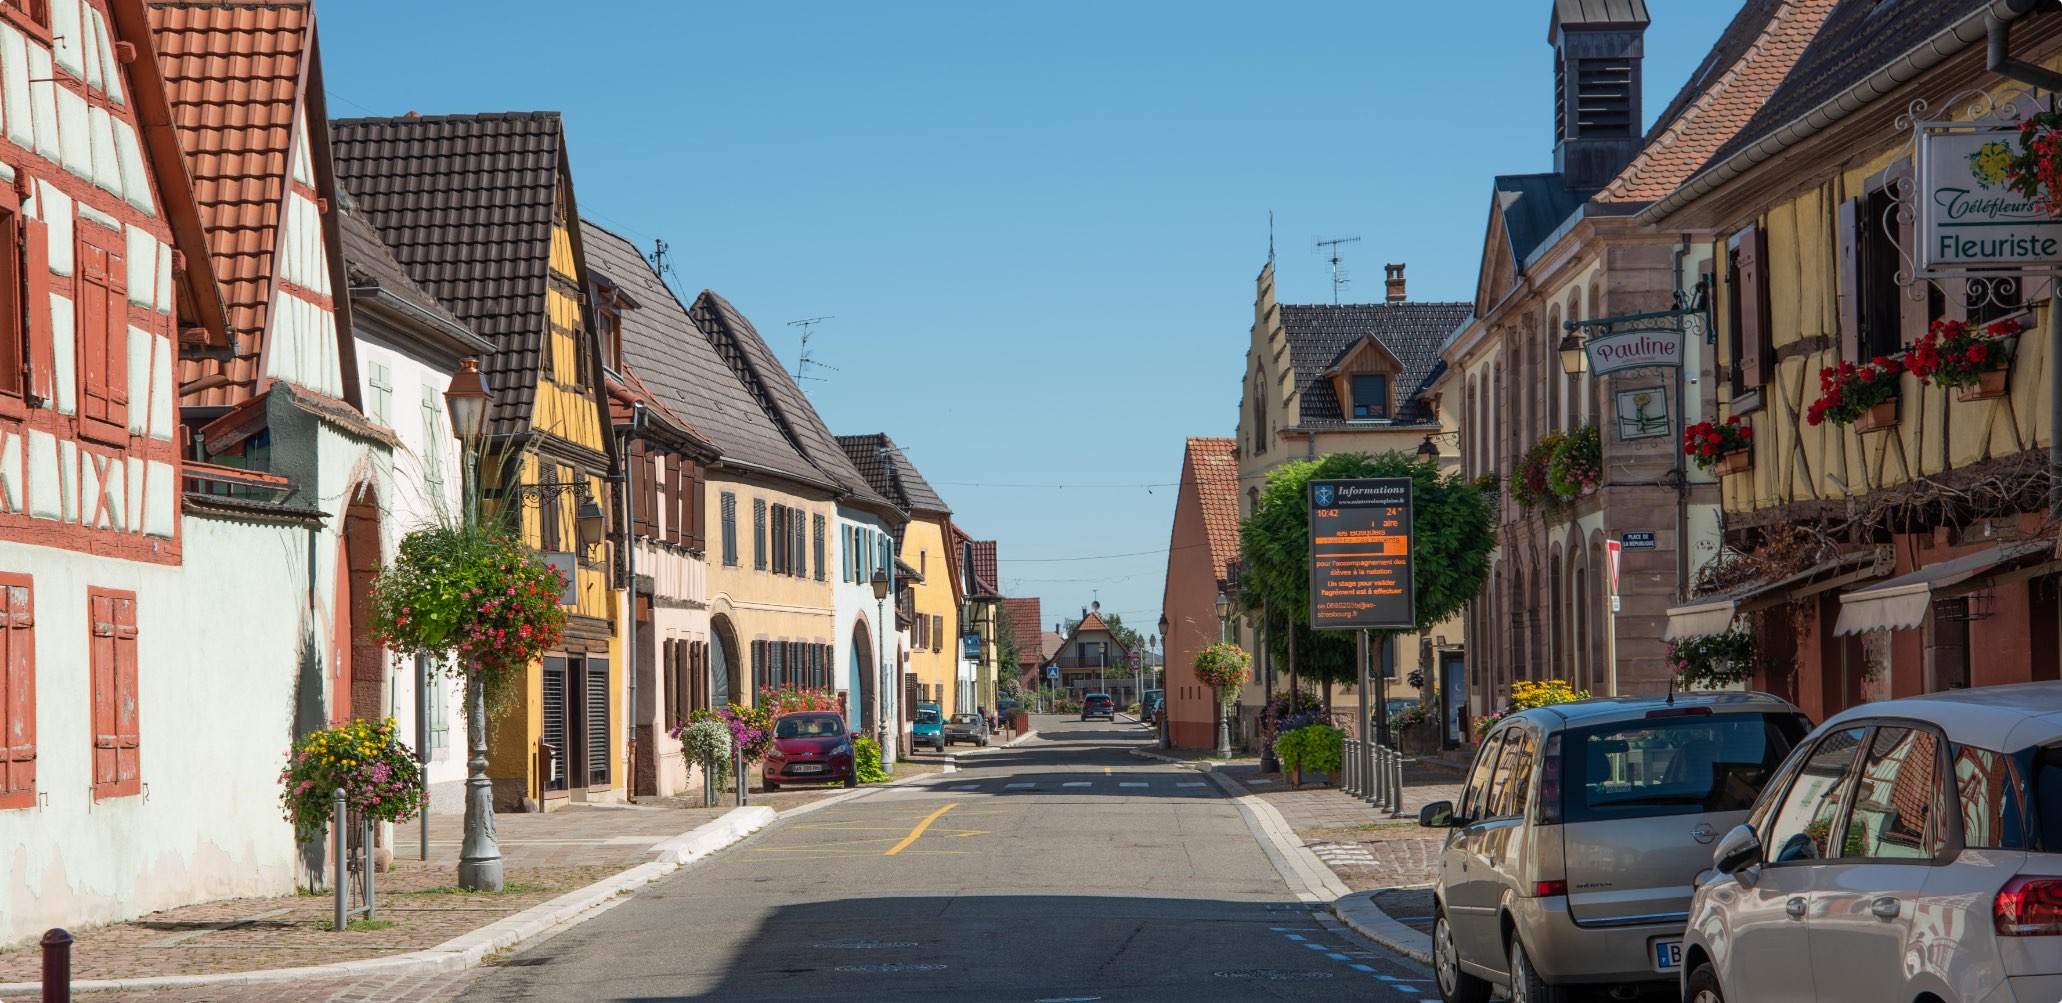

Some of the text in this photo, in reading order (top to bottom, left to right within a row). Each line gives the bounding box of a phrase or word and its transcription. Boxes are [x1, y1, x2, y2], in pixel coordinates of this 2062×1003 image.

[1934, 187, 2034, 219] Téléfleurs
[1940, 233, 2058, 259] Fleuriste
[1597, 336, 1676, 362] Pauline
[1339, 486, 1404, 497] Informations
[1317, 509, 1339, 517] 10:42
[1321, 589, 1355, 597] l'agrément
